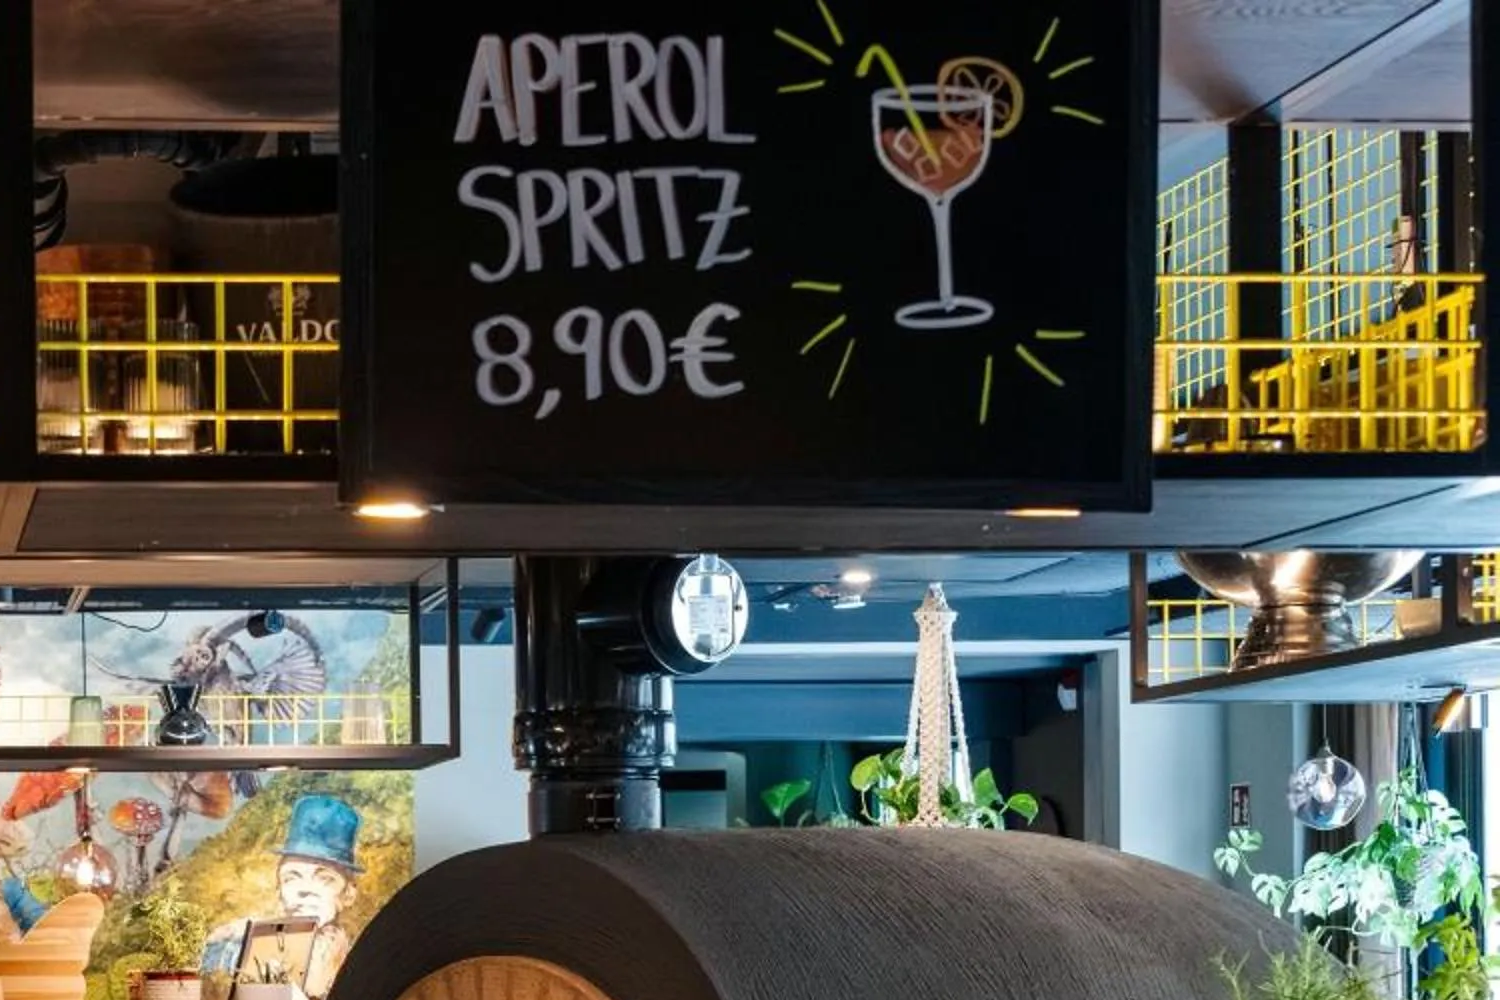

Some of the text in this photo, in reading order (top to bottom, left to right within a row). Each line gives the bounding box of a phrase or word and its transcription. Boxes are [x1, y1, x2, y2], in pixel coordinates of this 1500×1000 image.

[454, 33, 757, 146] APEROL
[458, 165, 753, 283] SPRITZ
[472, 302, 745, 420] 8,90€
